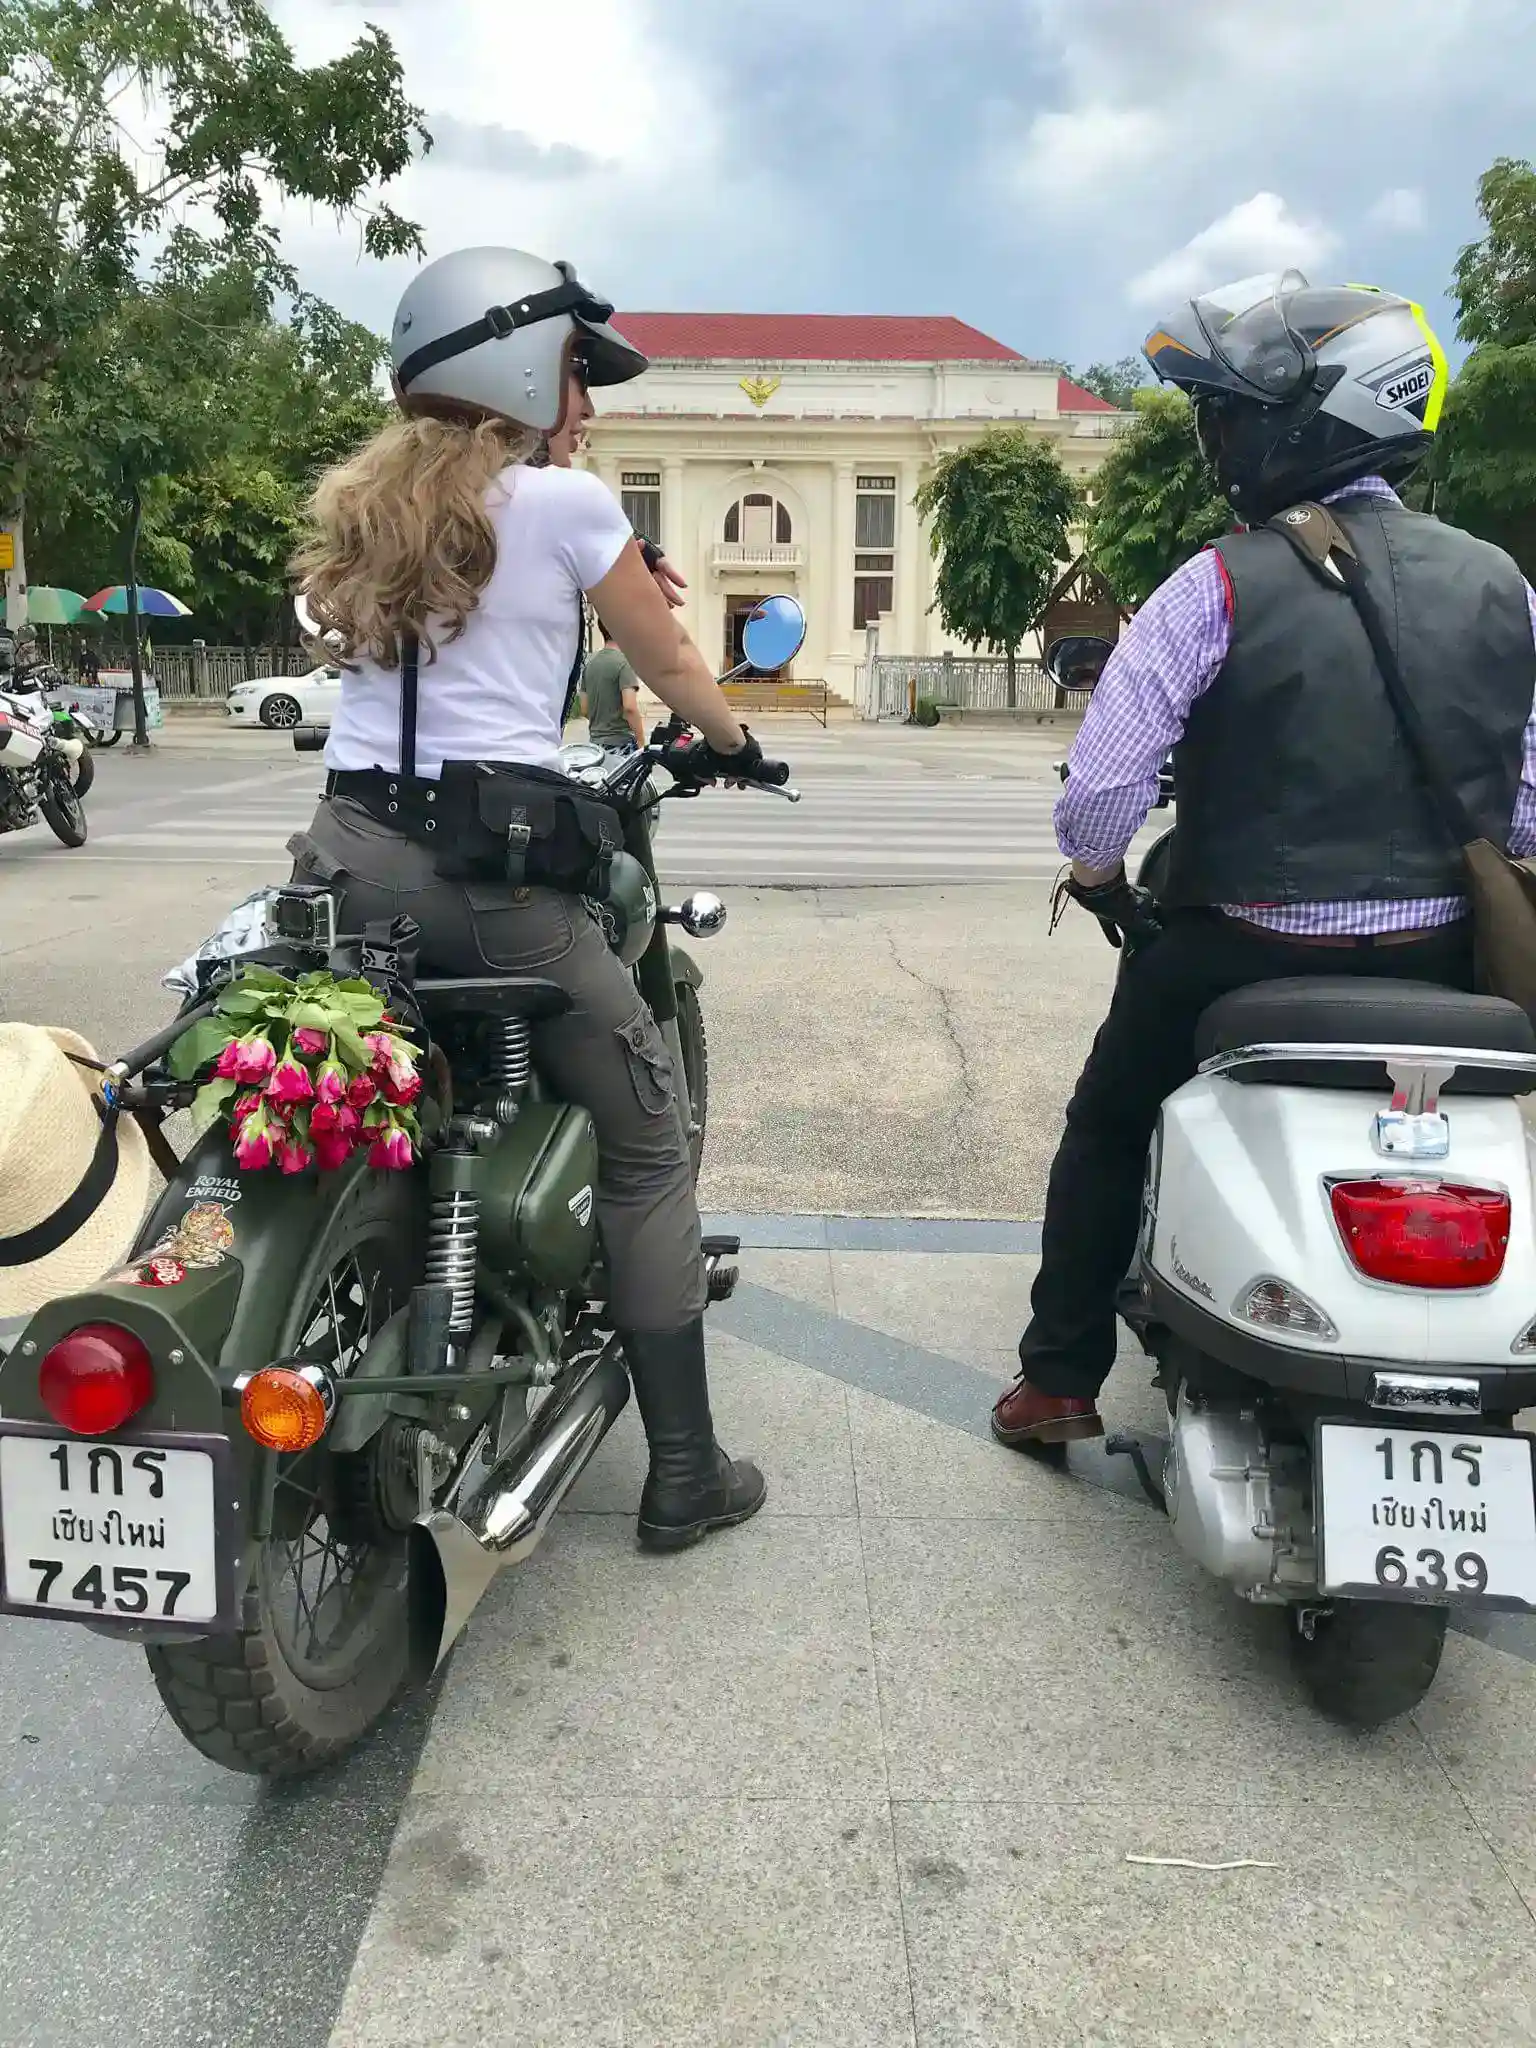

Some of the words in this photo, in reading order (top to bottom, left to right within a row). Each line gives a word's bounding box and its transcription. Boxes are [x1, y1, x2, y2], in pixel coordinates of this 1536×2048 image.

[1386, 370, 1429, 404] SHOEI
[185, 1186, 242, 1201] ENFIELD
[195, 1175, 240, 1189] ROYAL
[52, 1508, 165, 1549] เชียงใหม่
[1372, 1496, 1487, 1533] เชียงใหม่
[28, 1558, 191, 1616] 7457
[1375, 1545, 1488, 1596] 639
